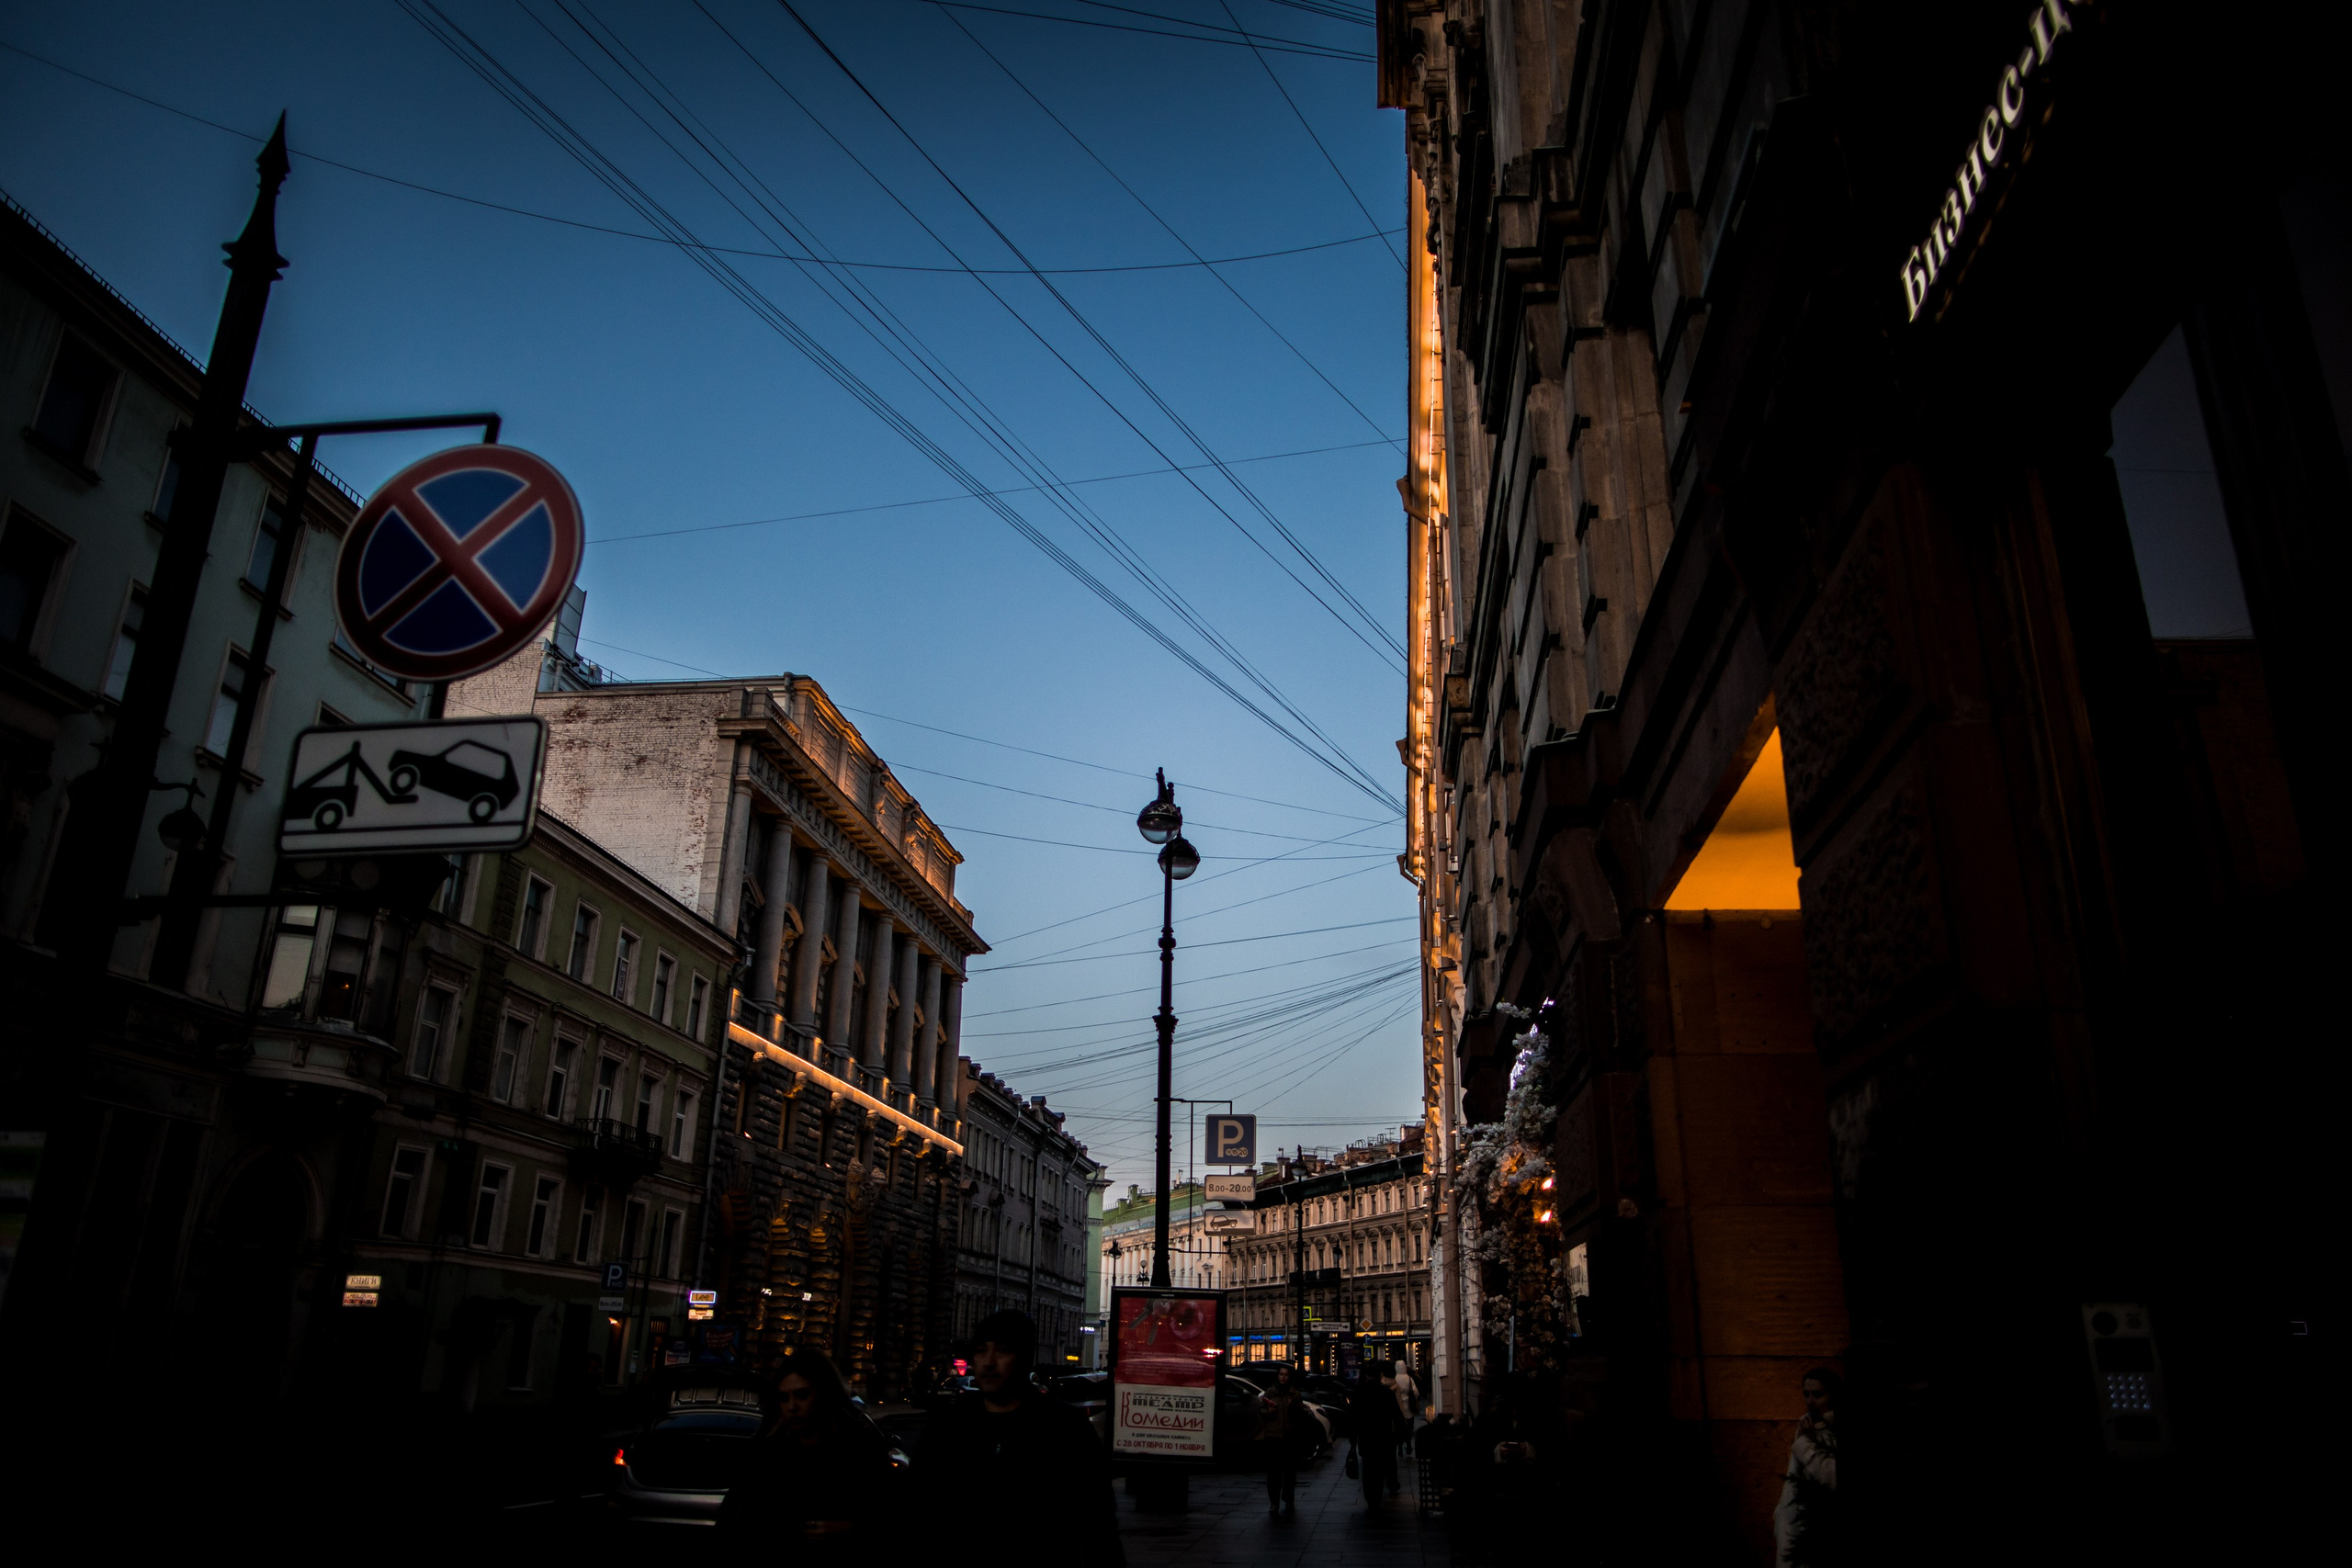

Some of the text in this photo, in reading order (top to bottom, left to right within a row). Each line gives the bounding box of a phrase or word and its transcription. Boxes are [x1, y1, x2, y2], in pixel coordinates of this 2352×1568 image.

[1900, 0, 2078, 322] Бизнес-Ц
[1208, 1183, 1251, 1192] 8.00-20.00
[350, 1277, 377, 1285] КНИГИ
[1134, 1440, 1163, 1449] ОКТЯБРЯ
[1164, 1441, 1172, 1450] ПО
[1179, 1443, 1205, 1451] НОЯБРЯ
